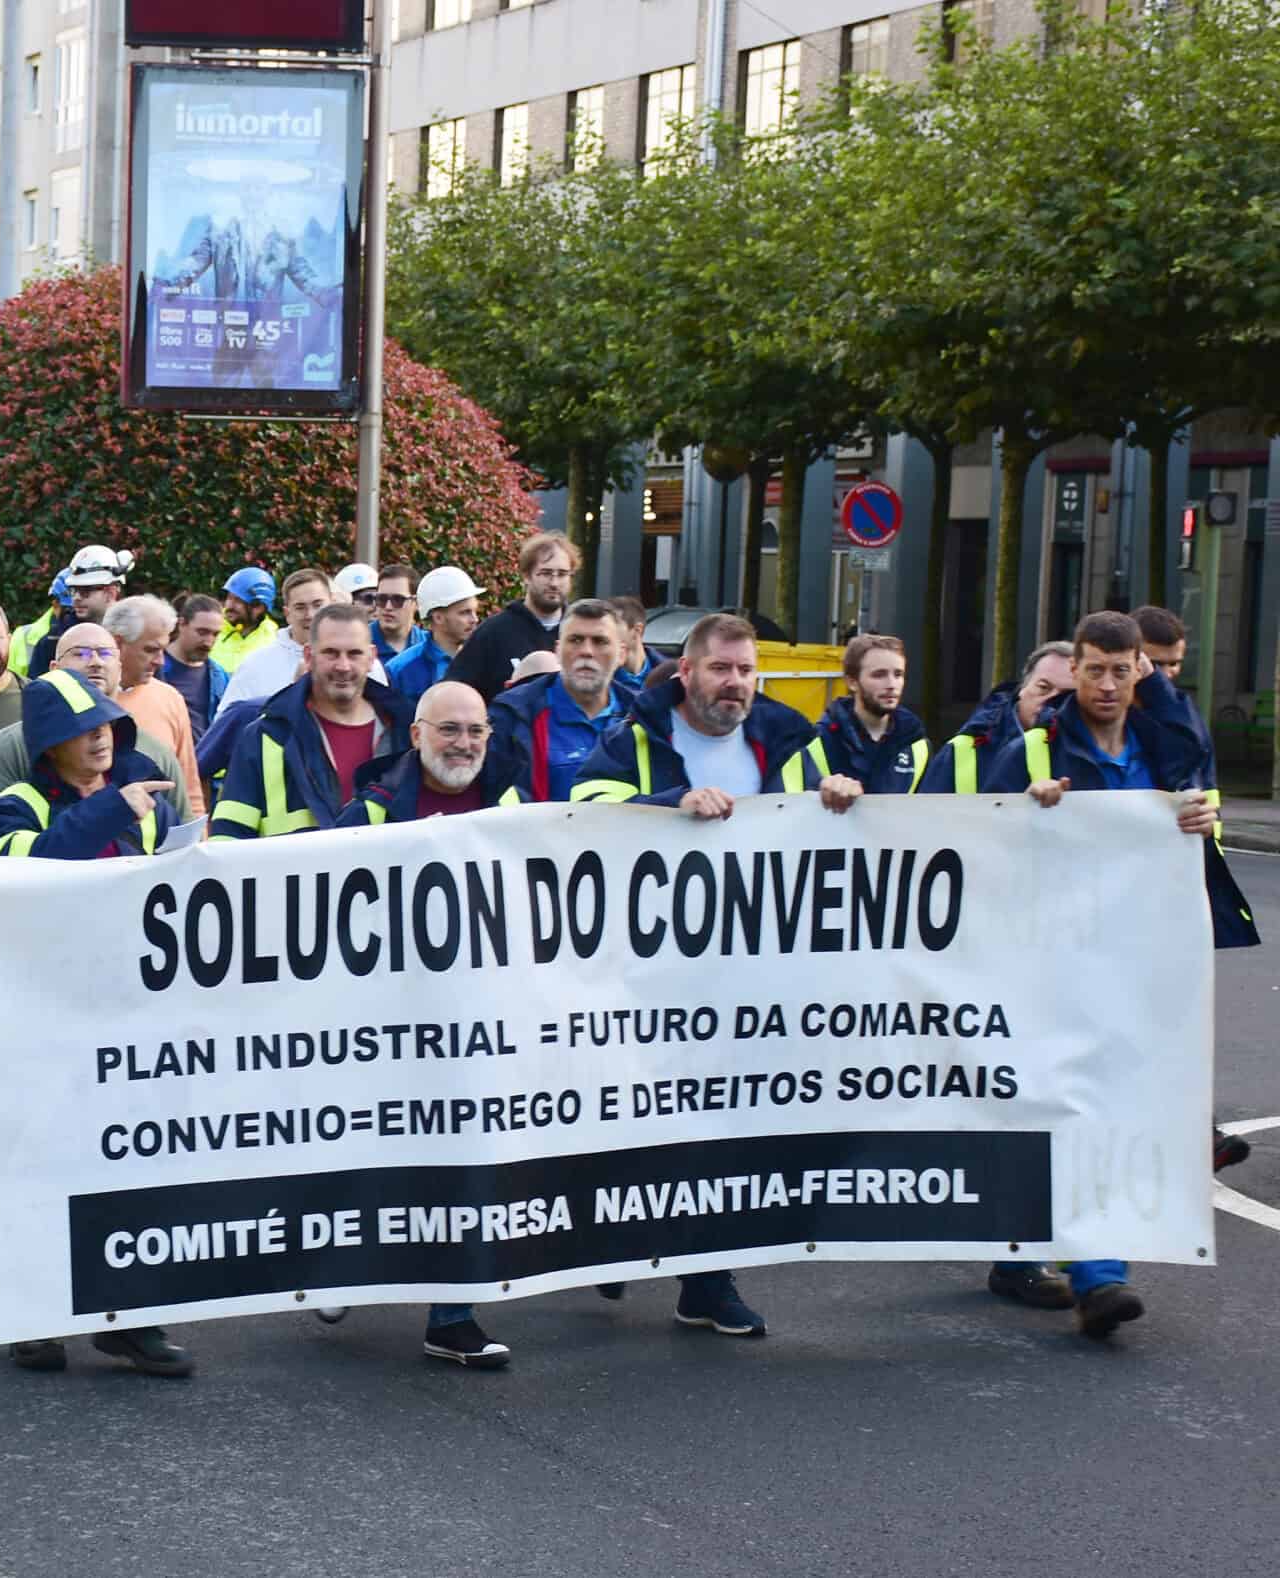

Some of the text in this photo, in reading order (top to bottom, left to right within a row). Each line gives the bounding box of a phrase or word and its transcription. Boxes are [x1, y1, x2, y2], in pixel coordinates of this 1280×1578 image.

[139, 847, 964, 992] SOLUCION DO CONVENIO
[96, 1038, 216, 1084] PLAN
[236, 1020, 518, 1072] INDUSTRIAL
[733, 1004, 787, 1040] DA
[801, 1002, 1011, 1038] COMARCA
[600, 1085, 619, 1121] E
[632, 1069, 824, 1119] DEREITOS
[837, 1064, 1018, 1101] SOCIAIS
[104, 1167, 980, 1269] COMITÉ DE EMPRESA NAVANTIA-FERROL
